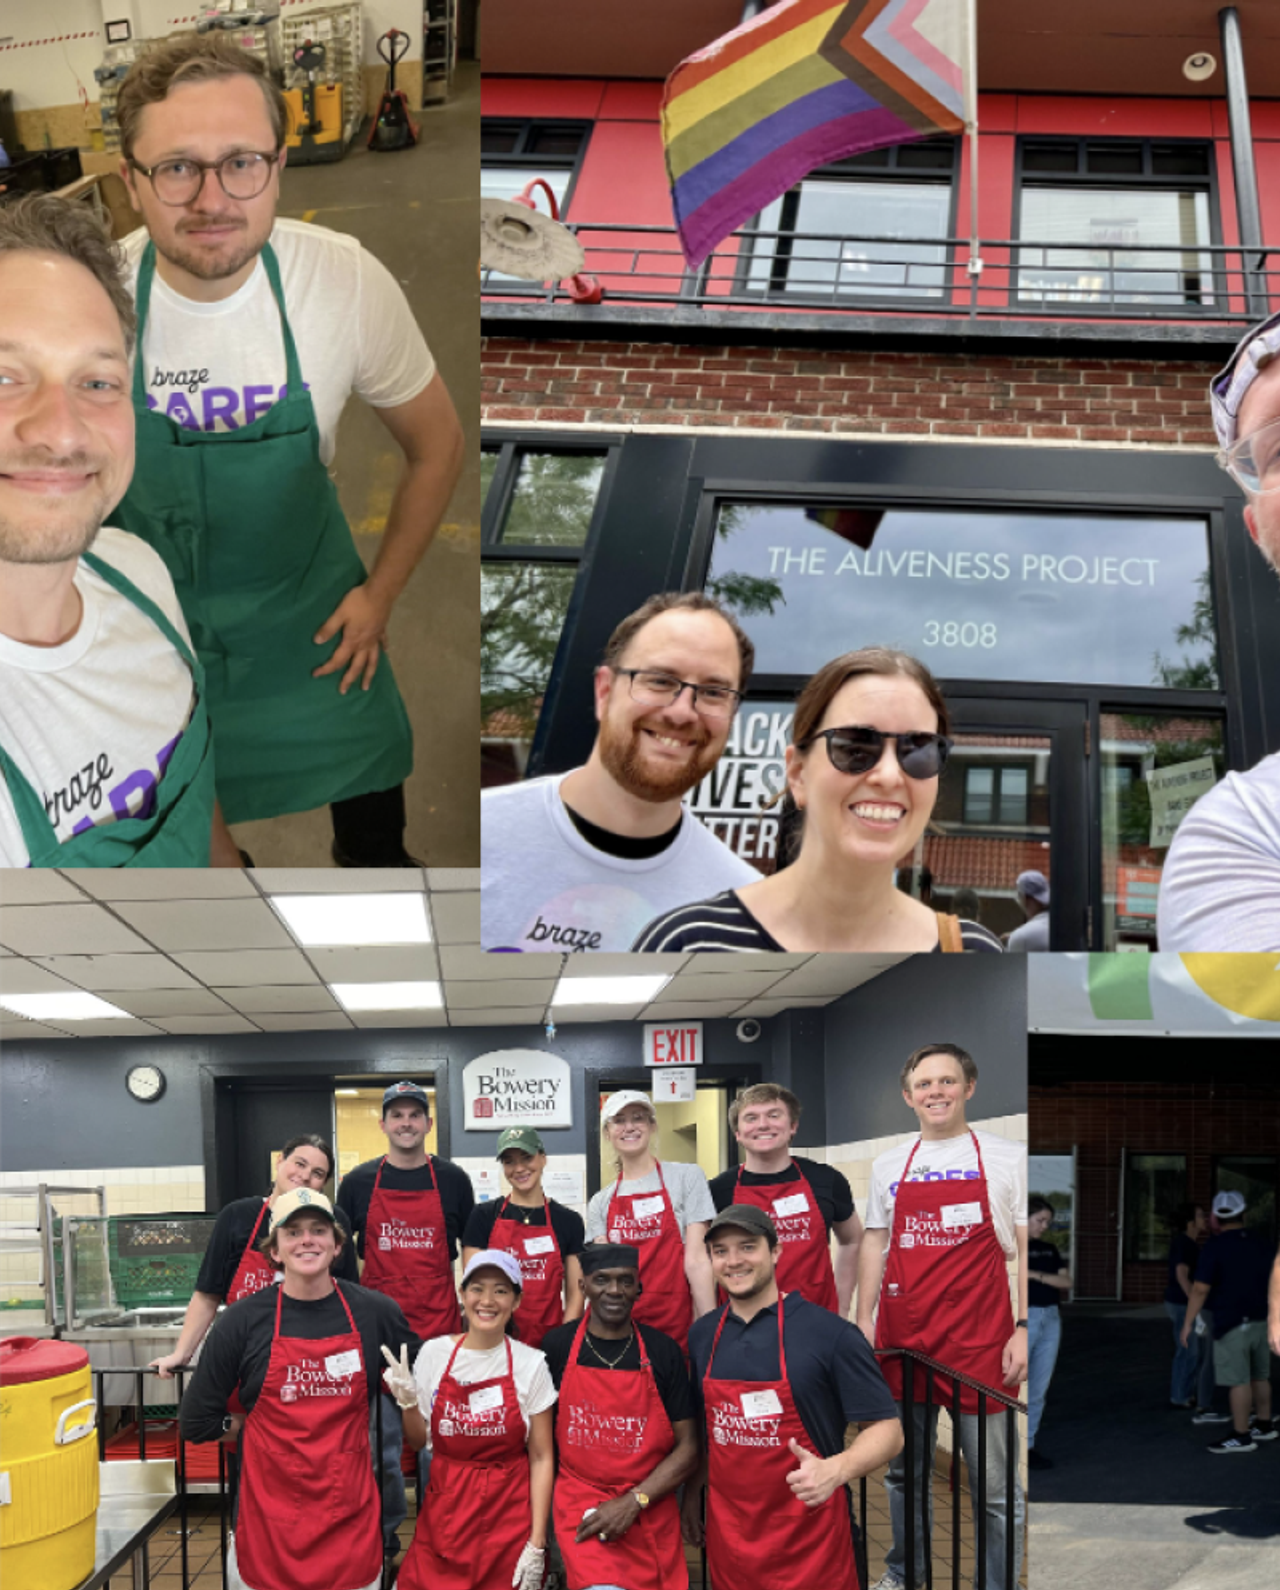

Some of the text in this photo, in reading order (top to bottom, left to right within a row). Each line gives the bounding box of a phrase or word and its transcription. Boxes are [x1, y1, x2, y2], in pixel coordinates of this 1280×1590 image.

[151, 366, 210, 393] braze
[767, 546, 1160, 586] THE ALIVENESS PROJECT
[922, 620, 997, 649] 3808
[726, 711, 796, 757] ACK
[682, 762, 784, 811] IVES
[700, 817, 780, 859] TTER
[526, 915, 602, 952] braze
[652, 1028, 699, 1062] EXIT
[492, 1066, 517, 1078] The
[477, 1074, 562, 1097] Bowery
[493, 1096, 556, 1112] Mission
[380, 1223, 435, 1239] Bowery
[774, 1215, 810, 1232] wery
[905, 1216, 972, 1236] Bowery
[392, 1237, 434, 1248] Mission
[915, 1233, 969, 1246] Mission
[519, 1258, 547, 1270] wery
[299, 1359, 320, 1368] The
[286, 1365, 354, 1383] Bowery
[299, 1382, 352, 1397] Mission
[453, 1421, 507, 1436] Mission
[568, 1404, 648, 1436] Bowery
[712, 1406, 781, 1434] Bowery
[584, 1430, 643, 1448] Mission
[727, 1428, 781, 1446] Mission
